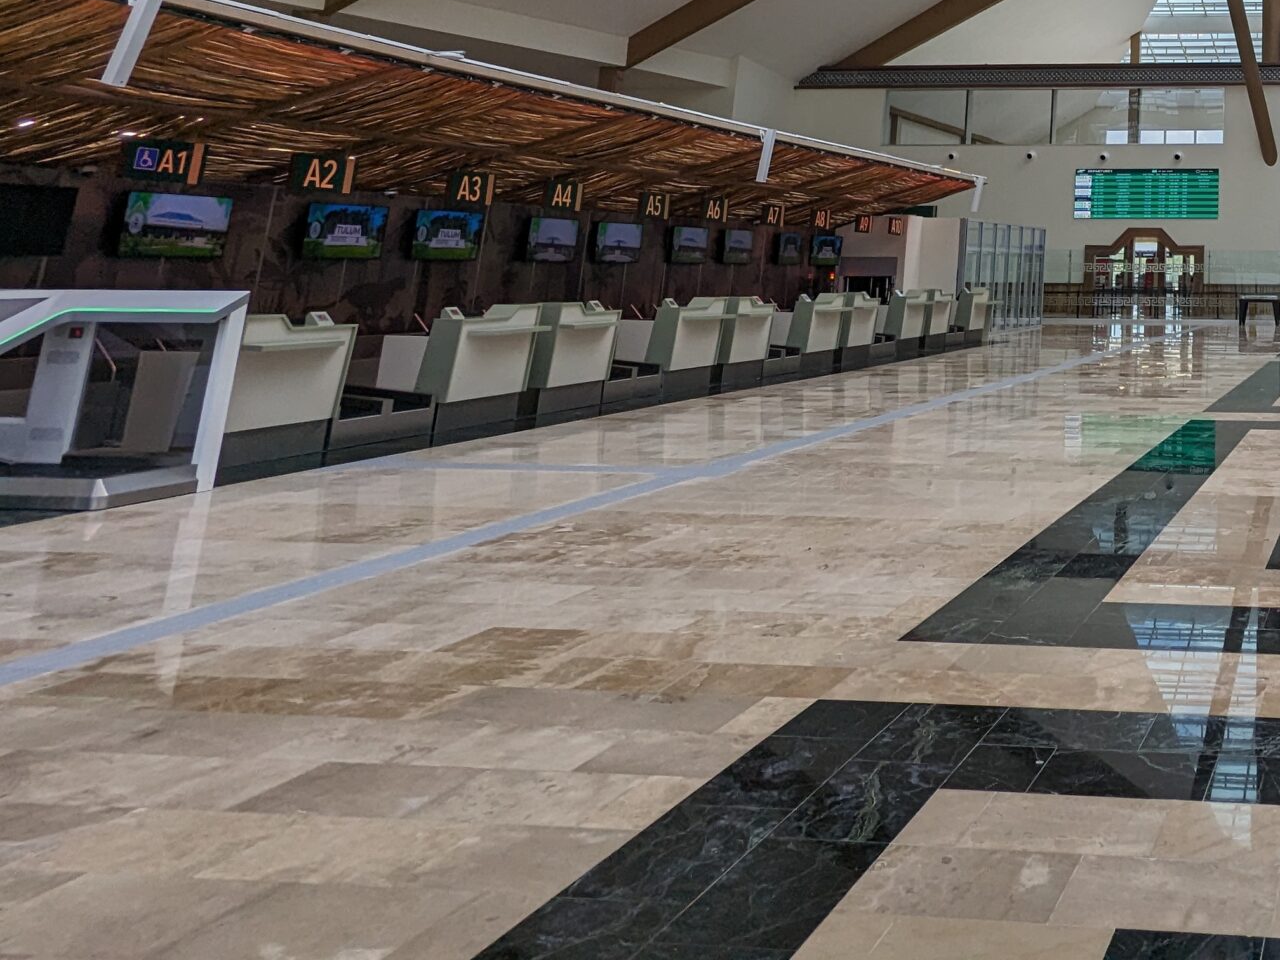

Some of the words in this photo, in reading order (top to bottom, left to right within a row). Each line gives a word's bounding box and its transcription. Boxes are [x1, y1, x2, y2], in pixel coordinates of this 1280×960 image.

[157, 149, 187, 176] A1
[303, 159, 339, 190] A2
[456, 176, 481, 202] A3
[551, 183, 573, 208] A4
[645, 196, 662, 217] A5
[705, 200, 721, 220] A6
[766, 206, 779, 225] A7
[814, 210, 826, 228] A8
[859, 216, 869, 231] A9
[891, 218, 902, 235] A10
